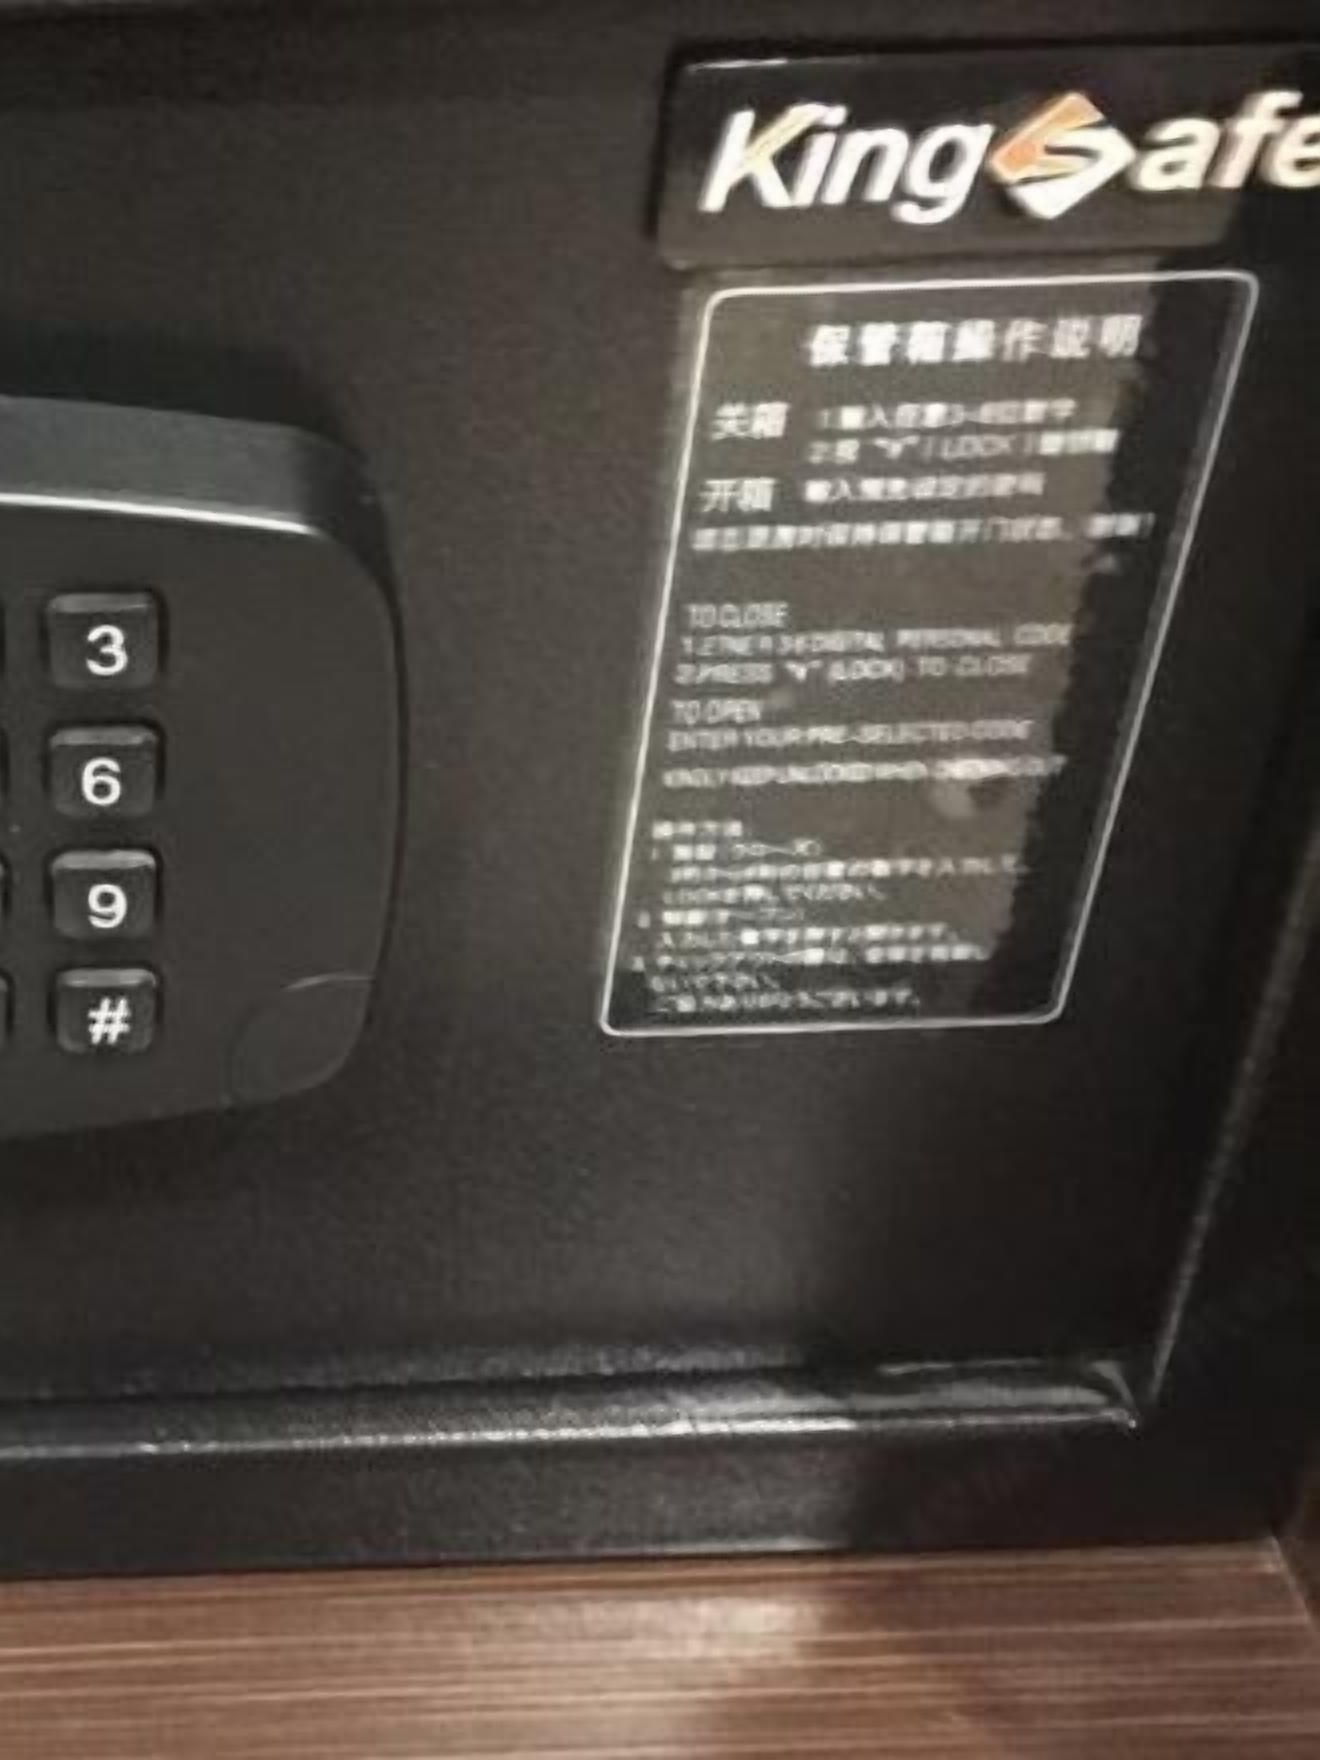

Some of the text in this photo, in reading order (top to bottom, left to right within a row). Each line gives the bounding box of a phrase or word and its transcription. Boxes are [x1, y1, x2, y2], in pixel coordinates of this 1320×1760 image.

[86, 624, 128, 676] 3
[81, 757, 122, 806] 6
[87, 884, 128, 929] 9
[87, 997, 132, 1046] #
